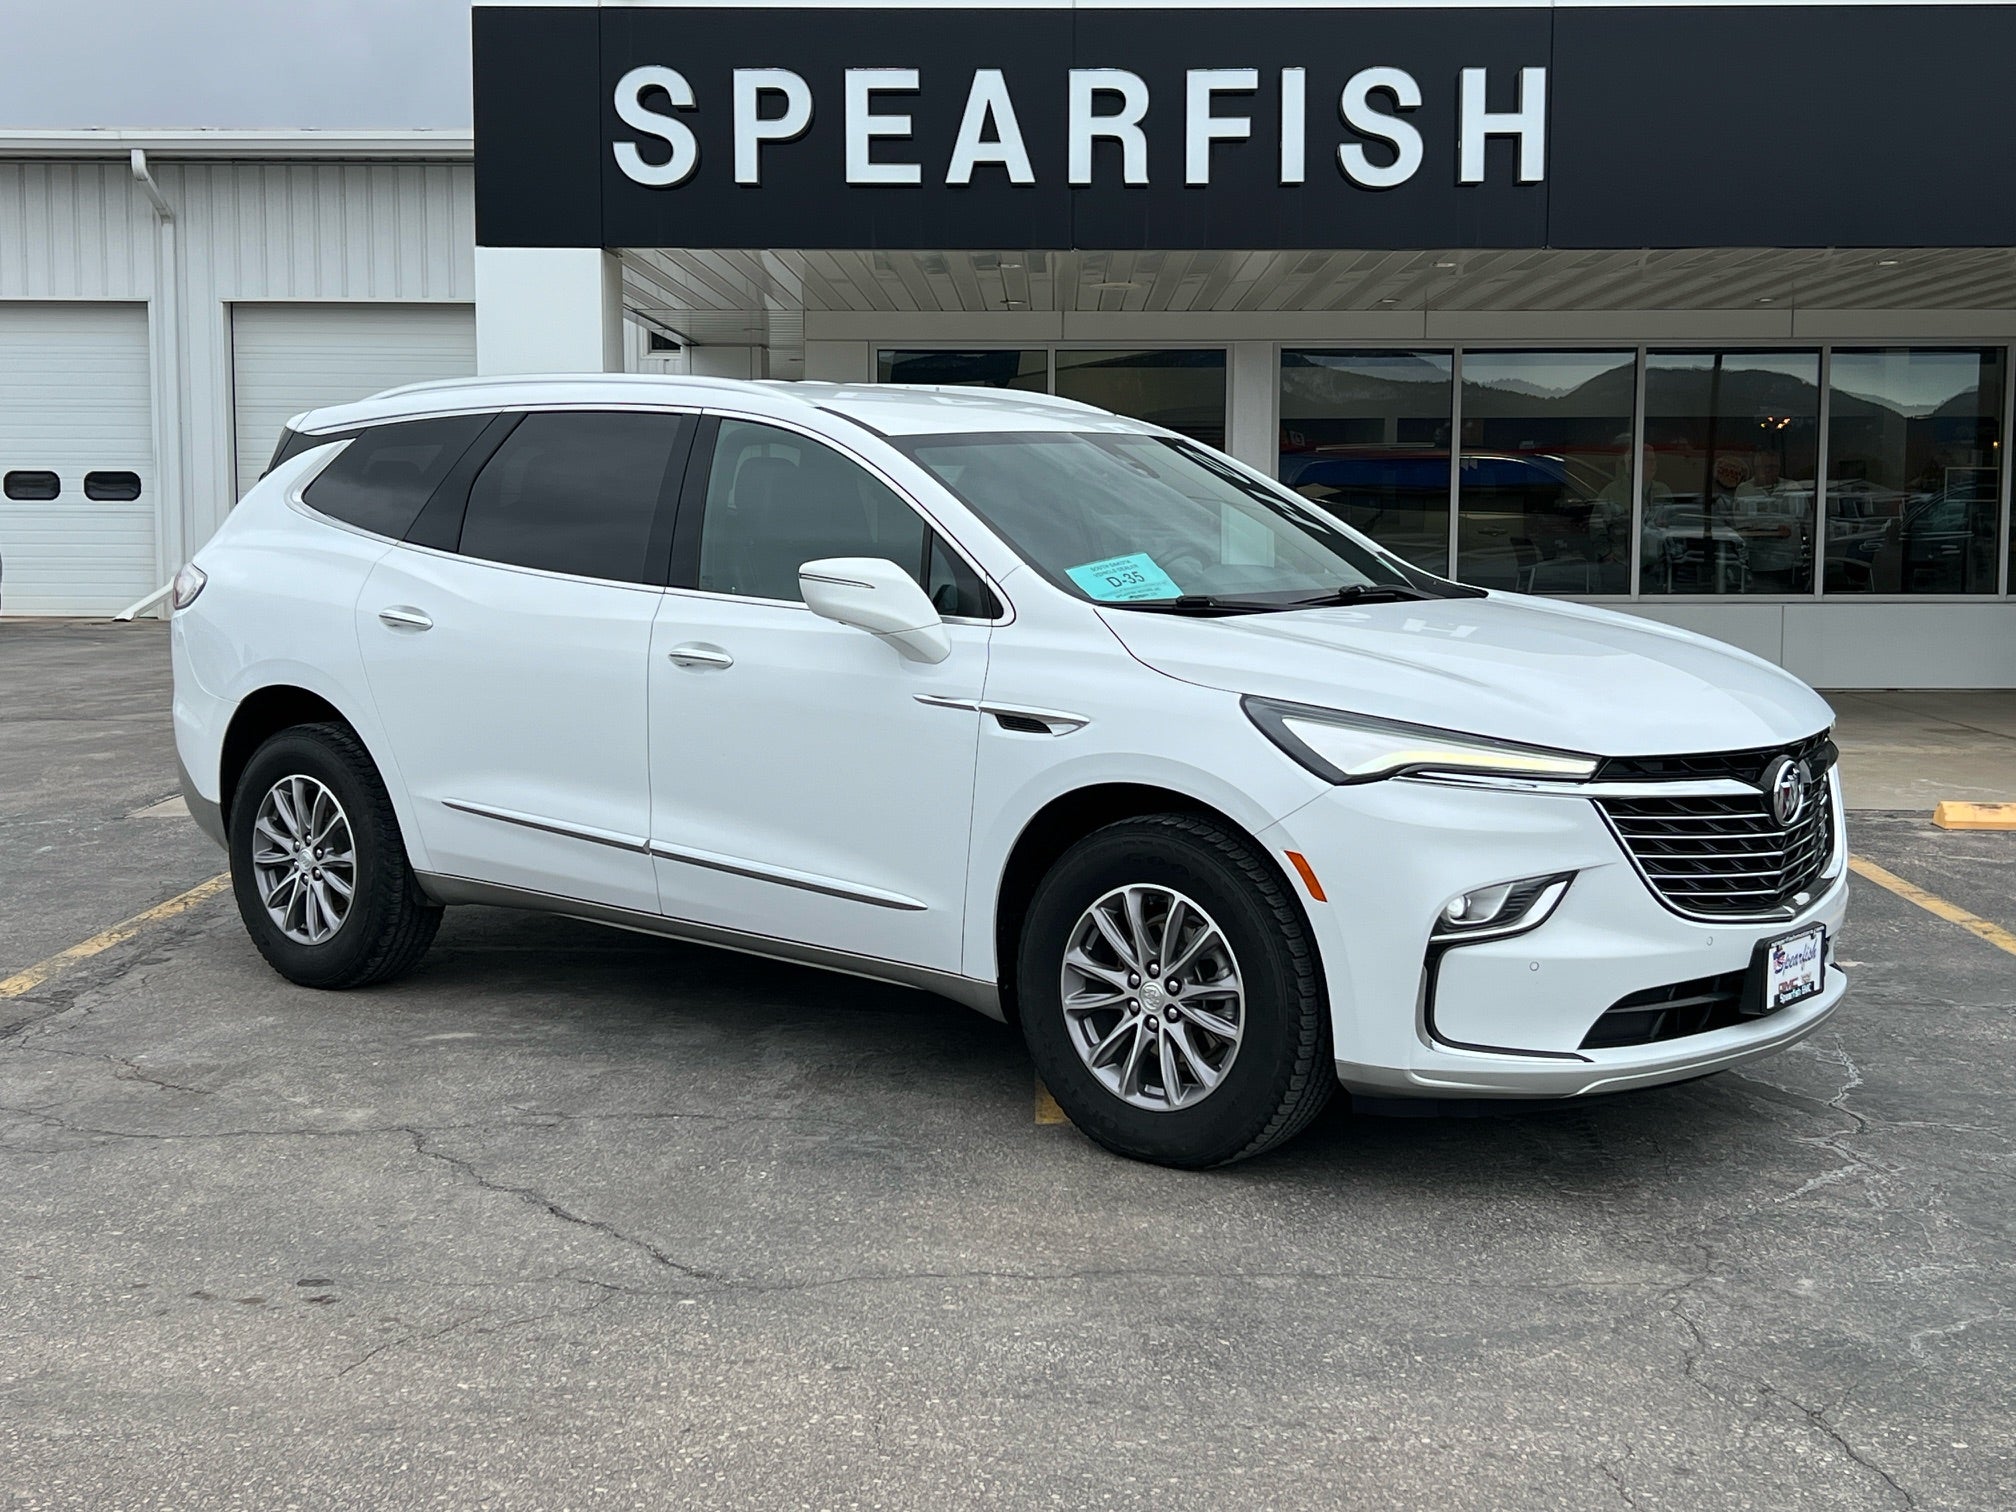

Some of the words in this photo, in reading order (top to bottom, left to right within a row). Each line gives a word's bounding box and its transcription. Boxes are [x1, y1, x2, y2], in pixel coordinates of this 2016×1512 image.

[612, 65, 1547, 187] SPEARFISH
[1106, 571, 1145, 588] D-35
[1773, 939, 1817, 976] Spearfish
